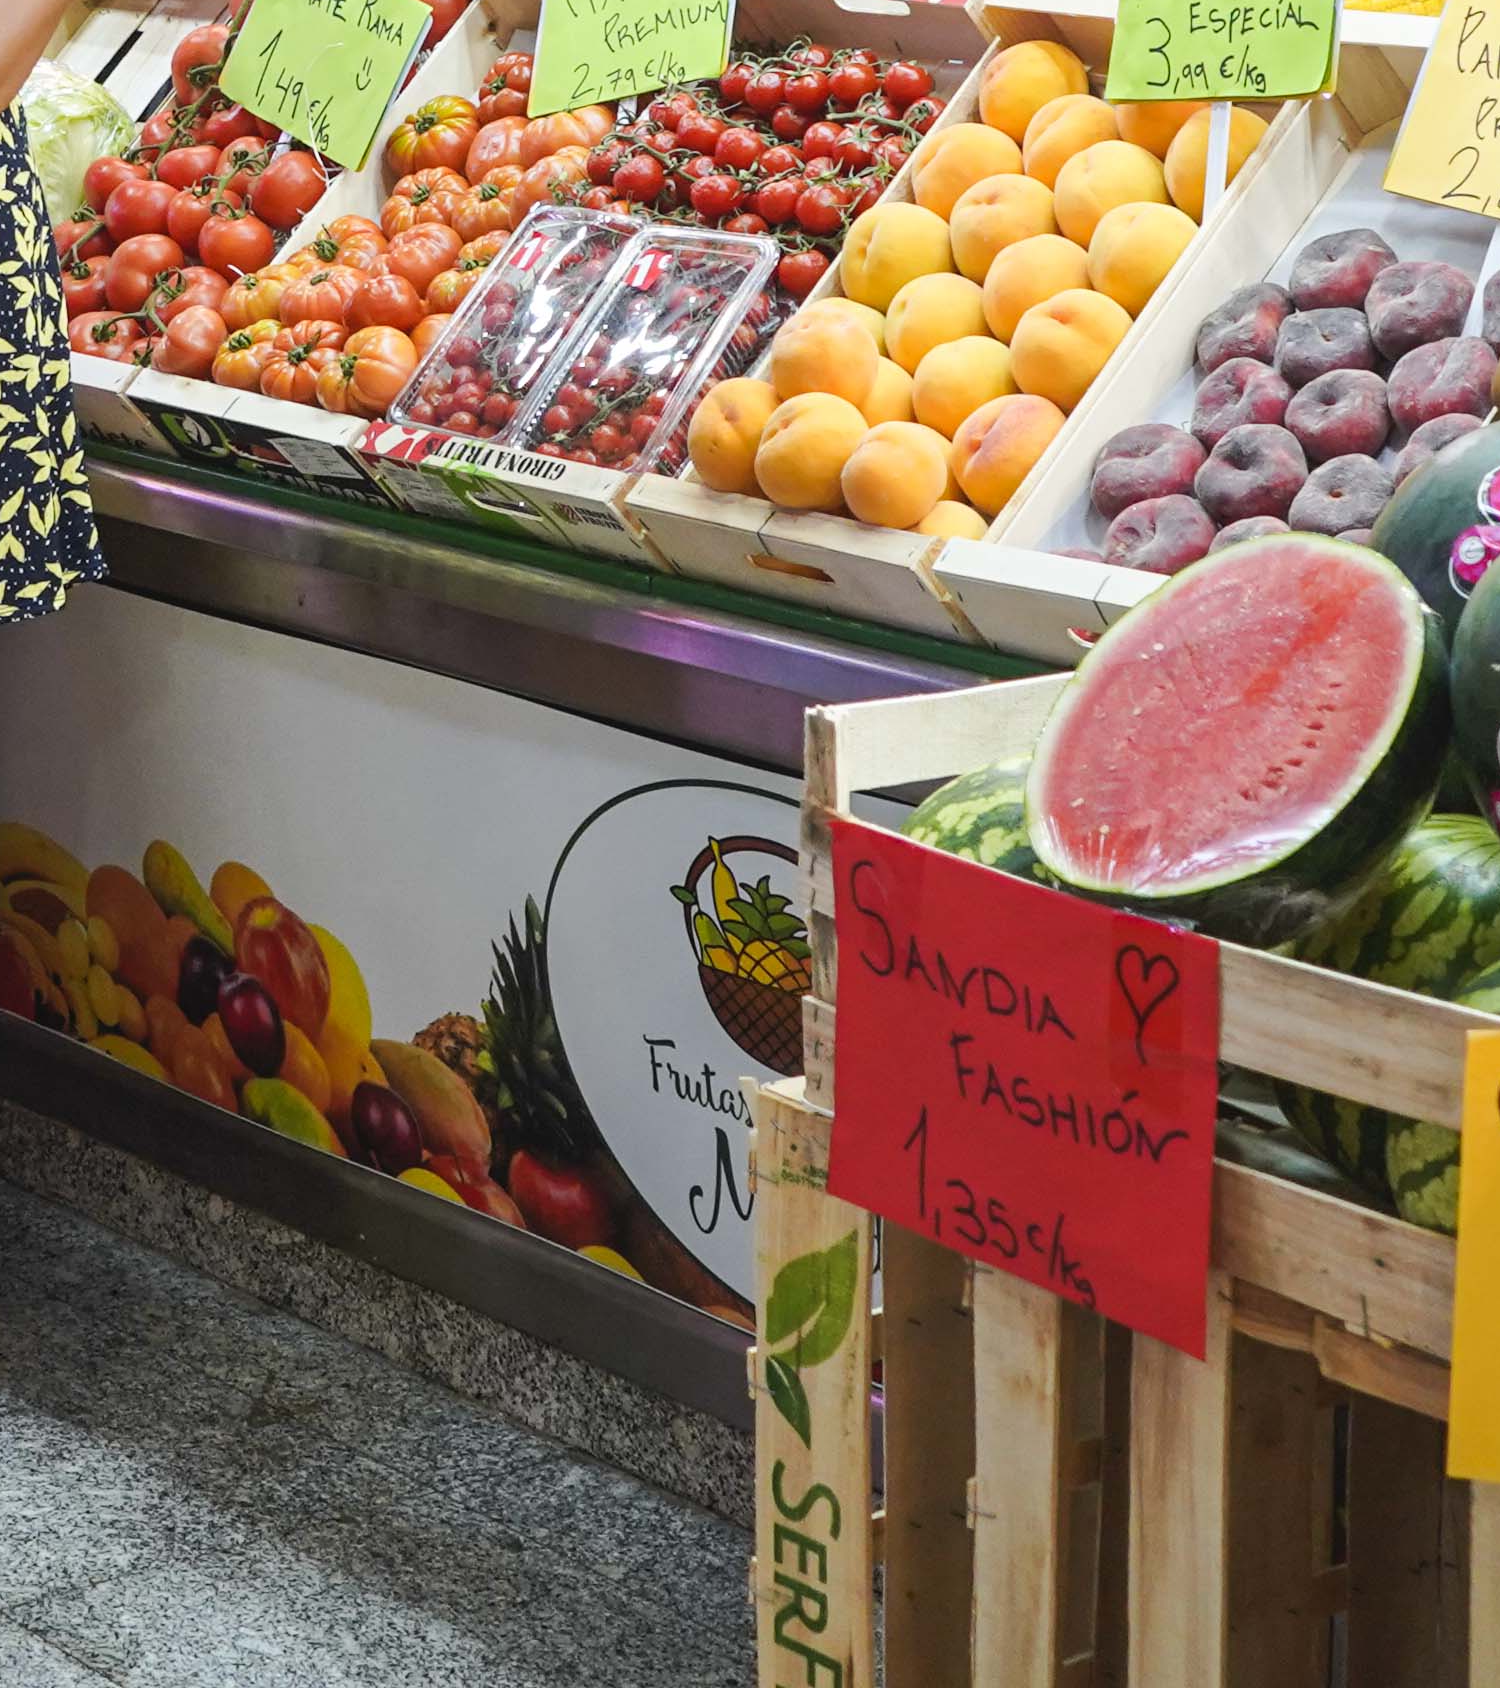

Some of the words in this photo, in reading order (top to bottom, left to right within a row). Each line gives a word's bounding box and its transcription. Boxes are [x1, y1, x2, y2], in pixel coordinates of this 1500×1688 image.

[602, 0, 729, 55] PREMIUM
[570, 62, 637, 102] 2,79
[493, 451, 567, 481] GIRONA
[849, 858, 1077, 1041] SANDIA
[643, 1033, 754, 1130] Frutas
[950, 1029, 1190, 1163] FASHIÓN
[771, 1457, 843, 1688] SERF
